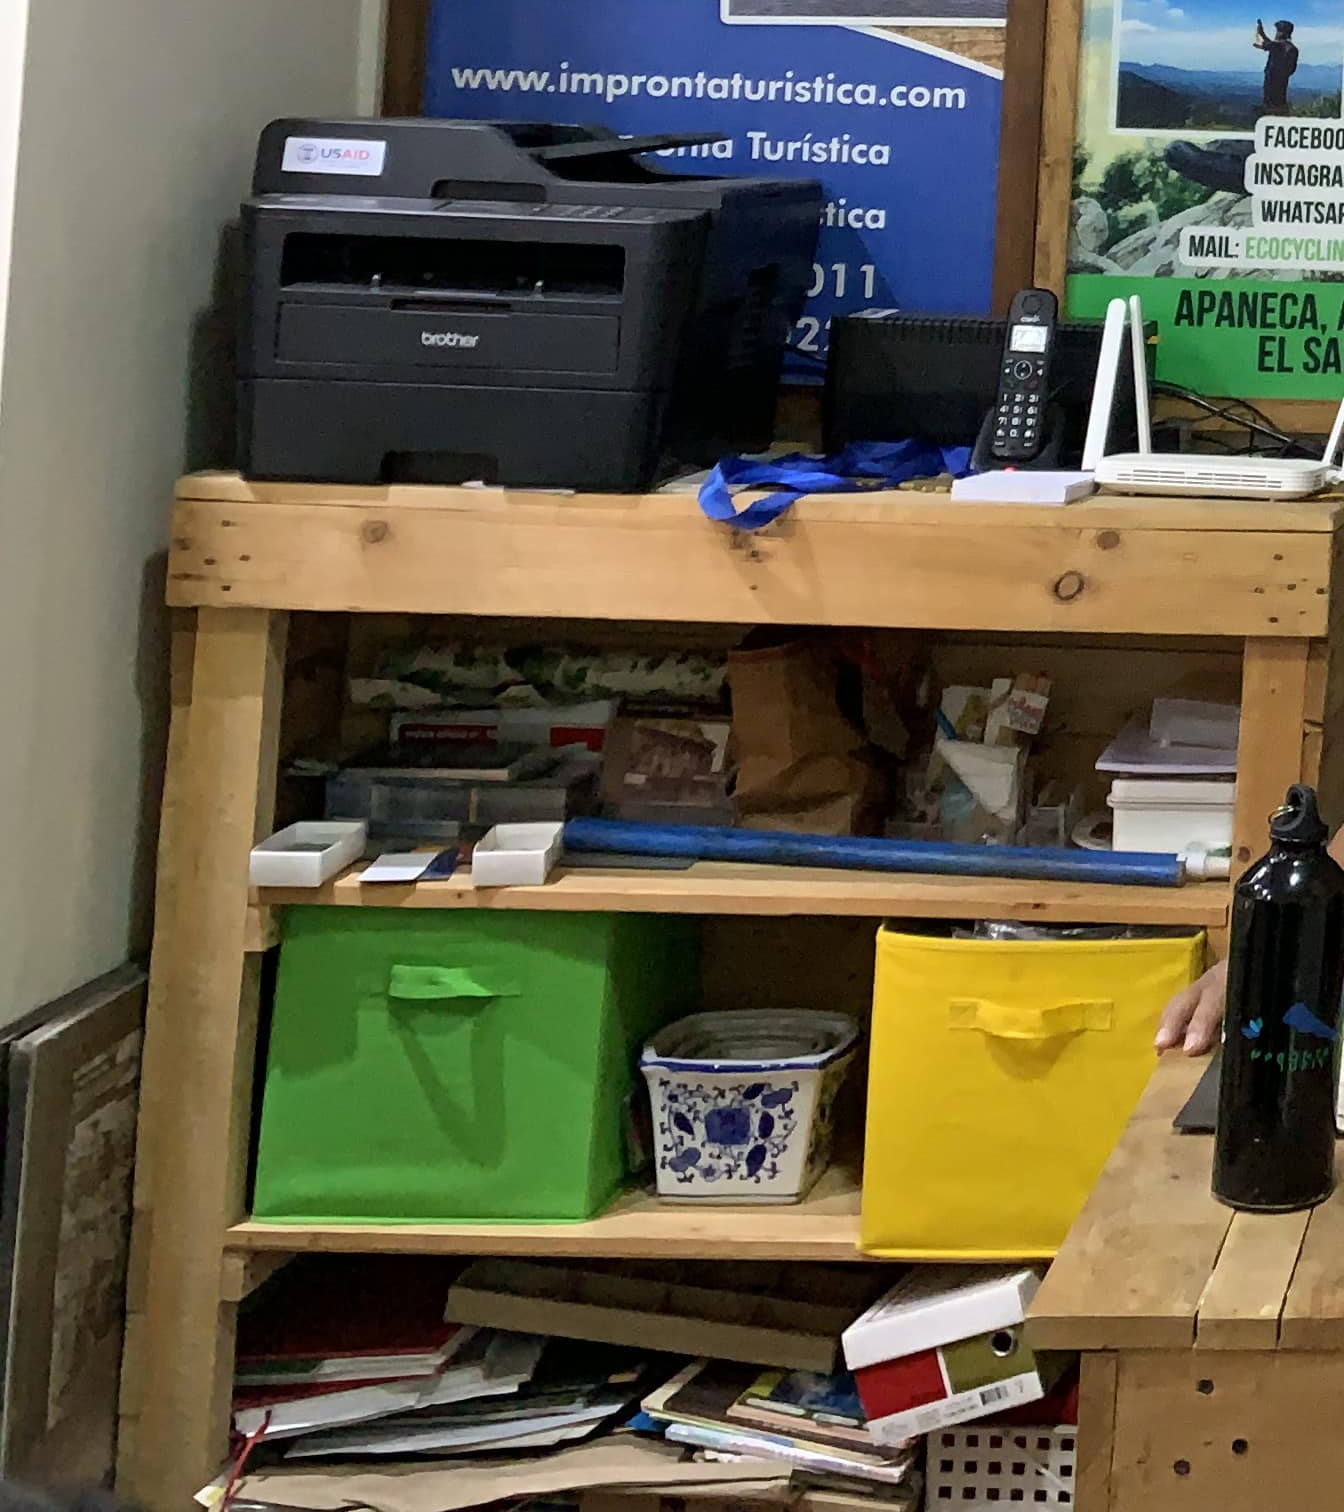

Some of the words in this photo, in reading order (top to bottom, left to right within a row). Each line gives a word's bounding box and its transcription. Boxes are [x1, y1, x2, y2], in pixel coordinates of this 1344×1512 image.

[451, 62, 967, 111] www.improntaturistica.com
[320, 146, 371, 162] USAID
[746, 131, 891, 166] Turística
[1188, 235, 1239, 259] MAIL:
[1175, 289, 1328, 334] APANECA,
[421, 331, 479, 349] brother
[1258, 335, 1293, 373] EL
